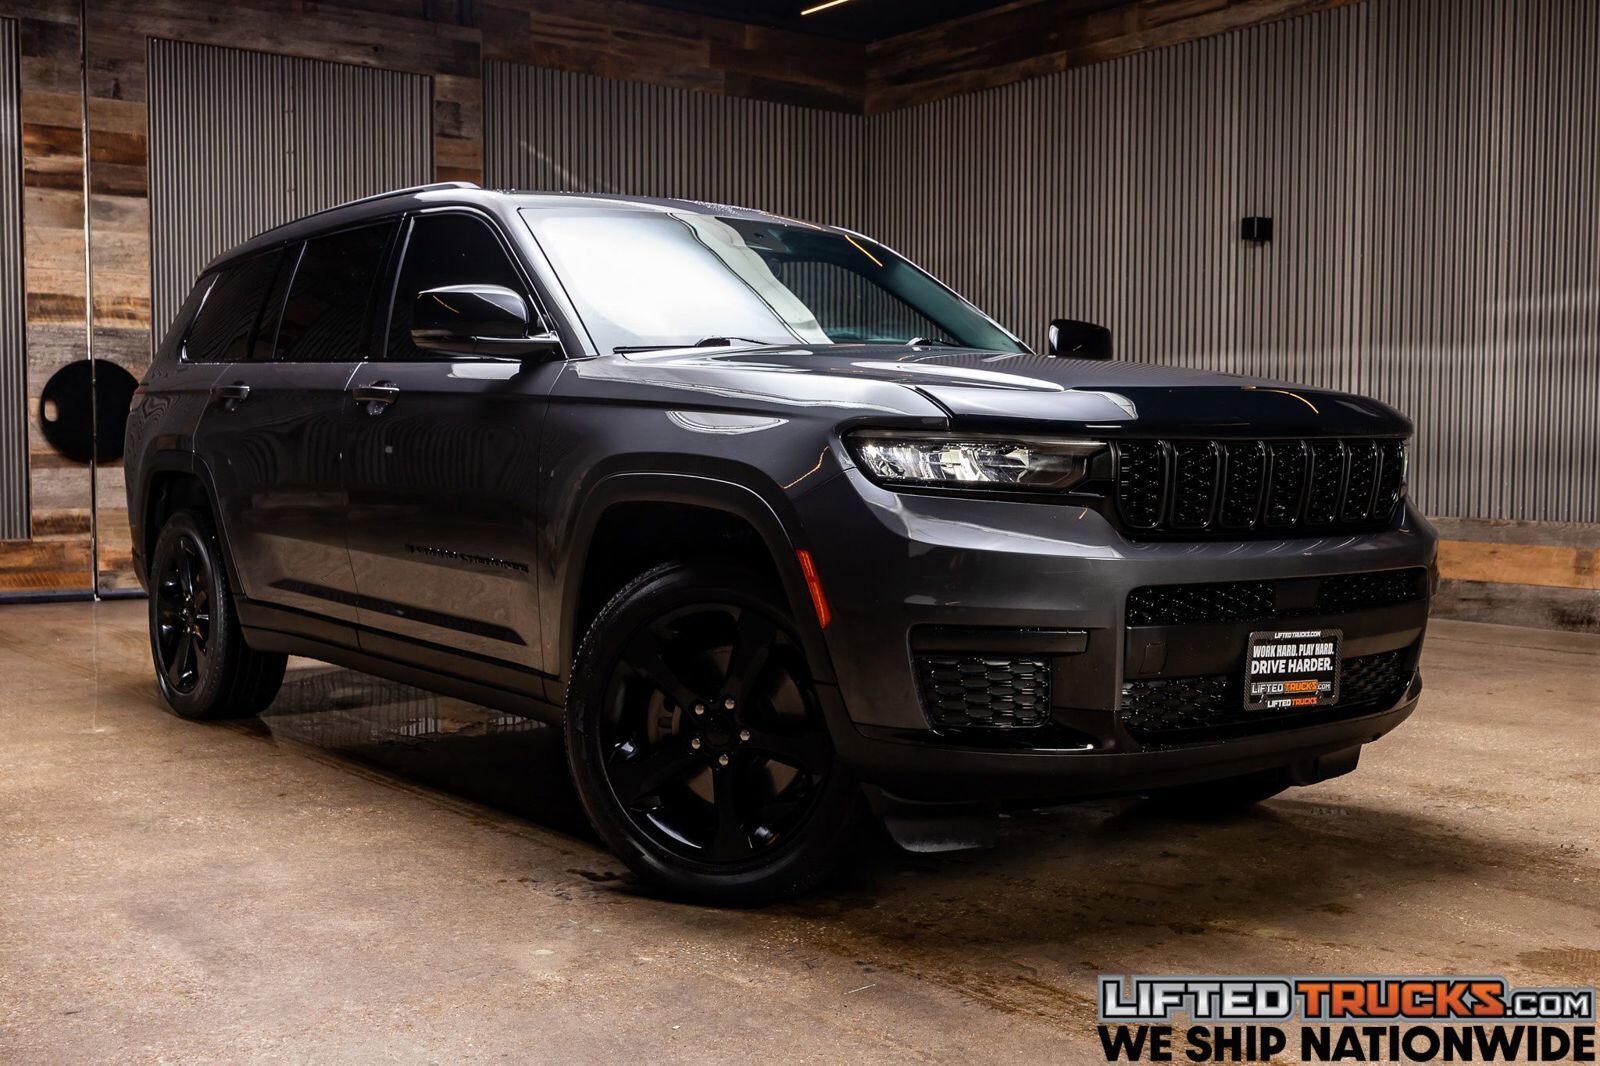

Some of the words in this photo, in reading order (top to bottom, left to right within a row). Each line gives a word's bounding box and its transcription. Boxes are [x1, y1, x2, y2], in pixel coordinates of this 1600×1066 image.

[1253, 644, 1276, 658] WORK
[1276, 644, 1298, 657] HARD.
[1299, 643, 1315, 656] PLAY
[1315, 642, 1334, 655] HARD.
[1251, 659, 1286, 674] DRIVE
[1288, 657, 1333, 673] HARDER.
